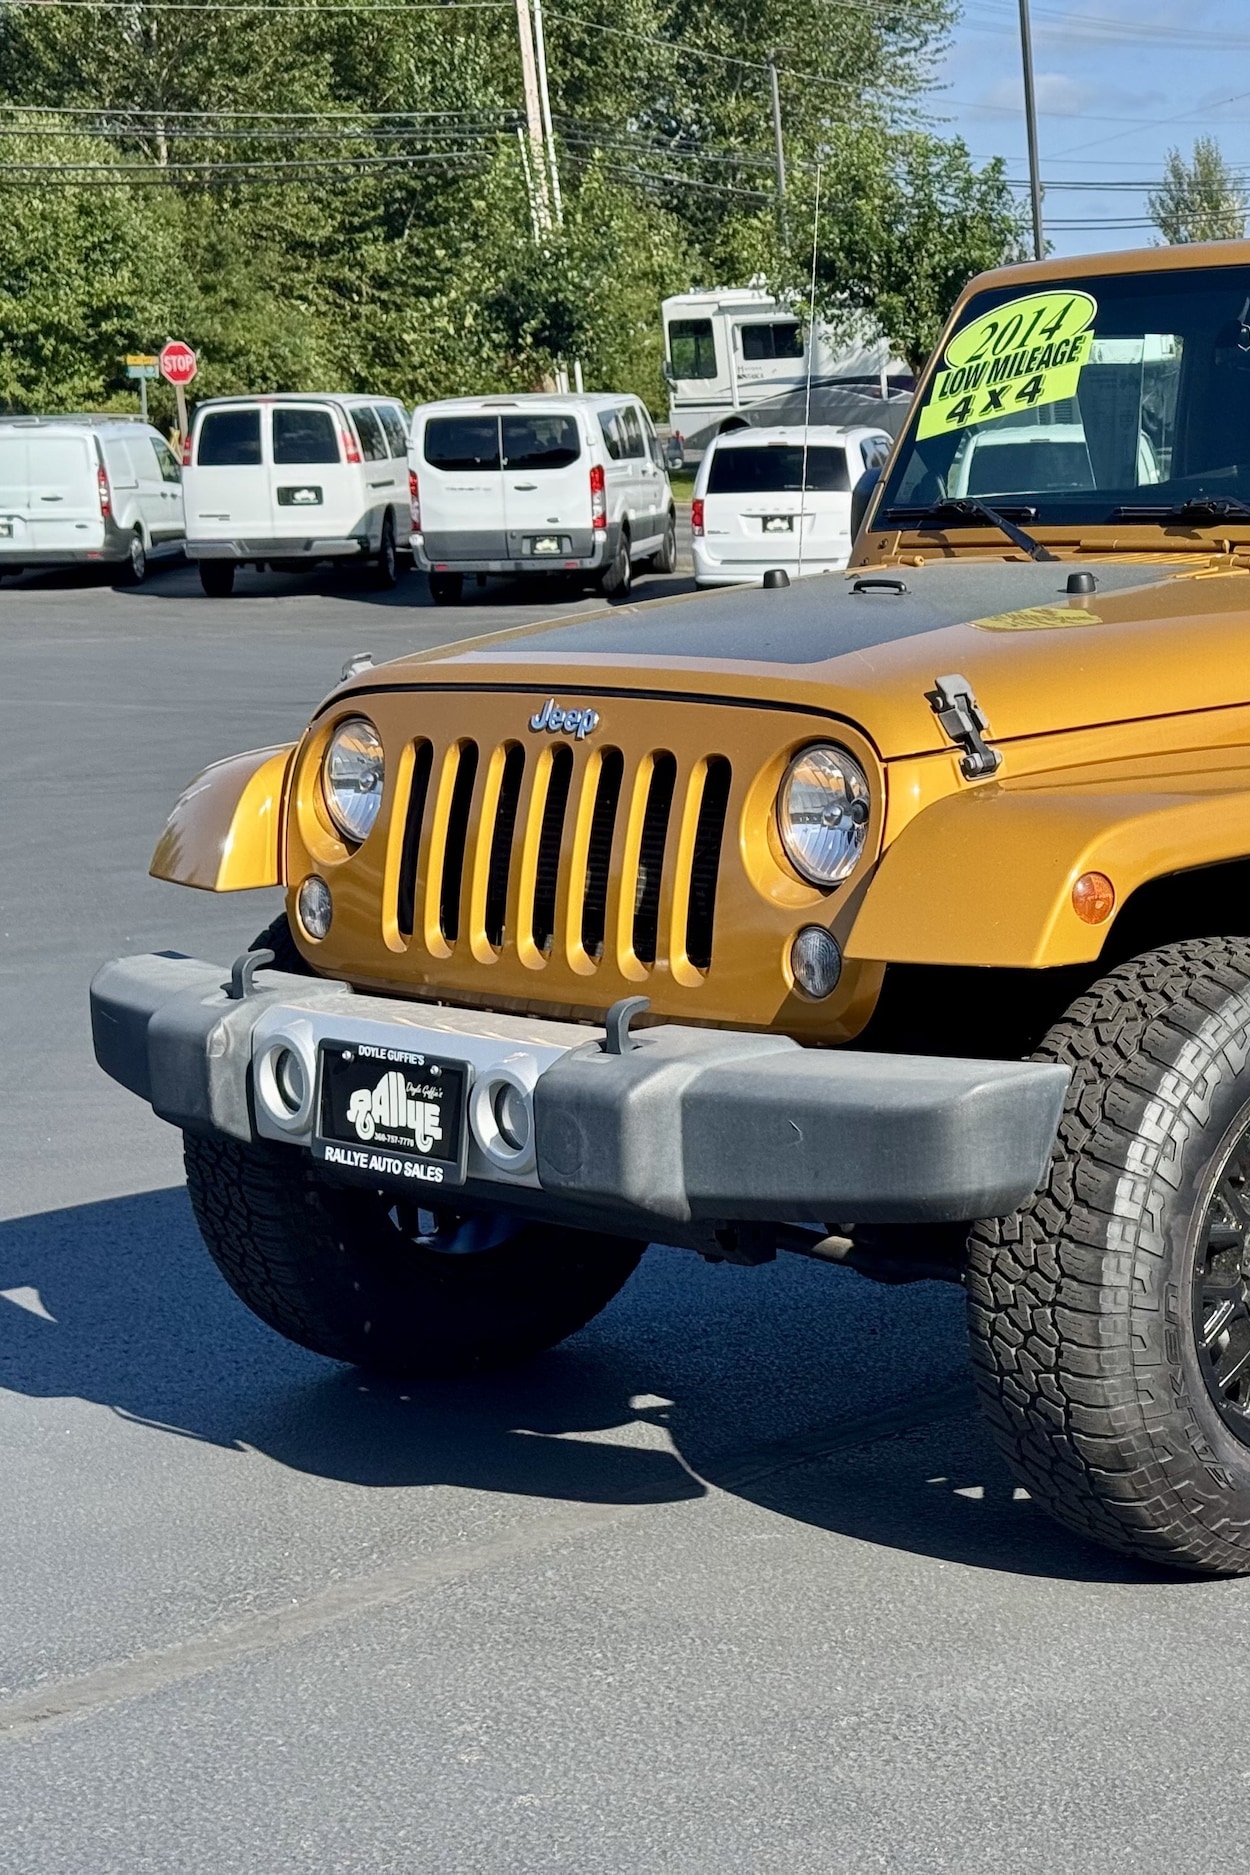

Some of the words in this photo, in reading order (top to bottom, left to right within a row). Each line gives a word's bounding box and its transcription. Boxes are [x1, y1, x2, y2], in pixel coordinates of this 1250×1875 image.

[965, 298, 1076, 364] 2014
[164, 354, 193, 373] STOP
[939, 361, 989, 401] LOW
[986, 335, 1087, 386] MILEAGE
[945, 395, 976, 425] 4
[1014, 374, 1047, 406] 4
[529, 697, 600, 740] Jeep
[358, 1044, 387, 1060] DOYLE
[387, 1049, 425, 1066] GUFFIE'S
[324, 1146, 369, 1169] RALLYE
[369, 1154, 402, 1175] AUTO
[403, 1162, 444, 1183] SALES
